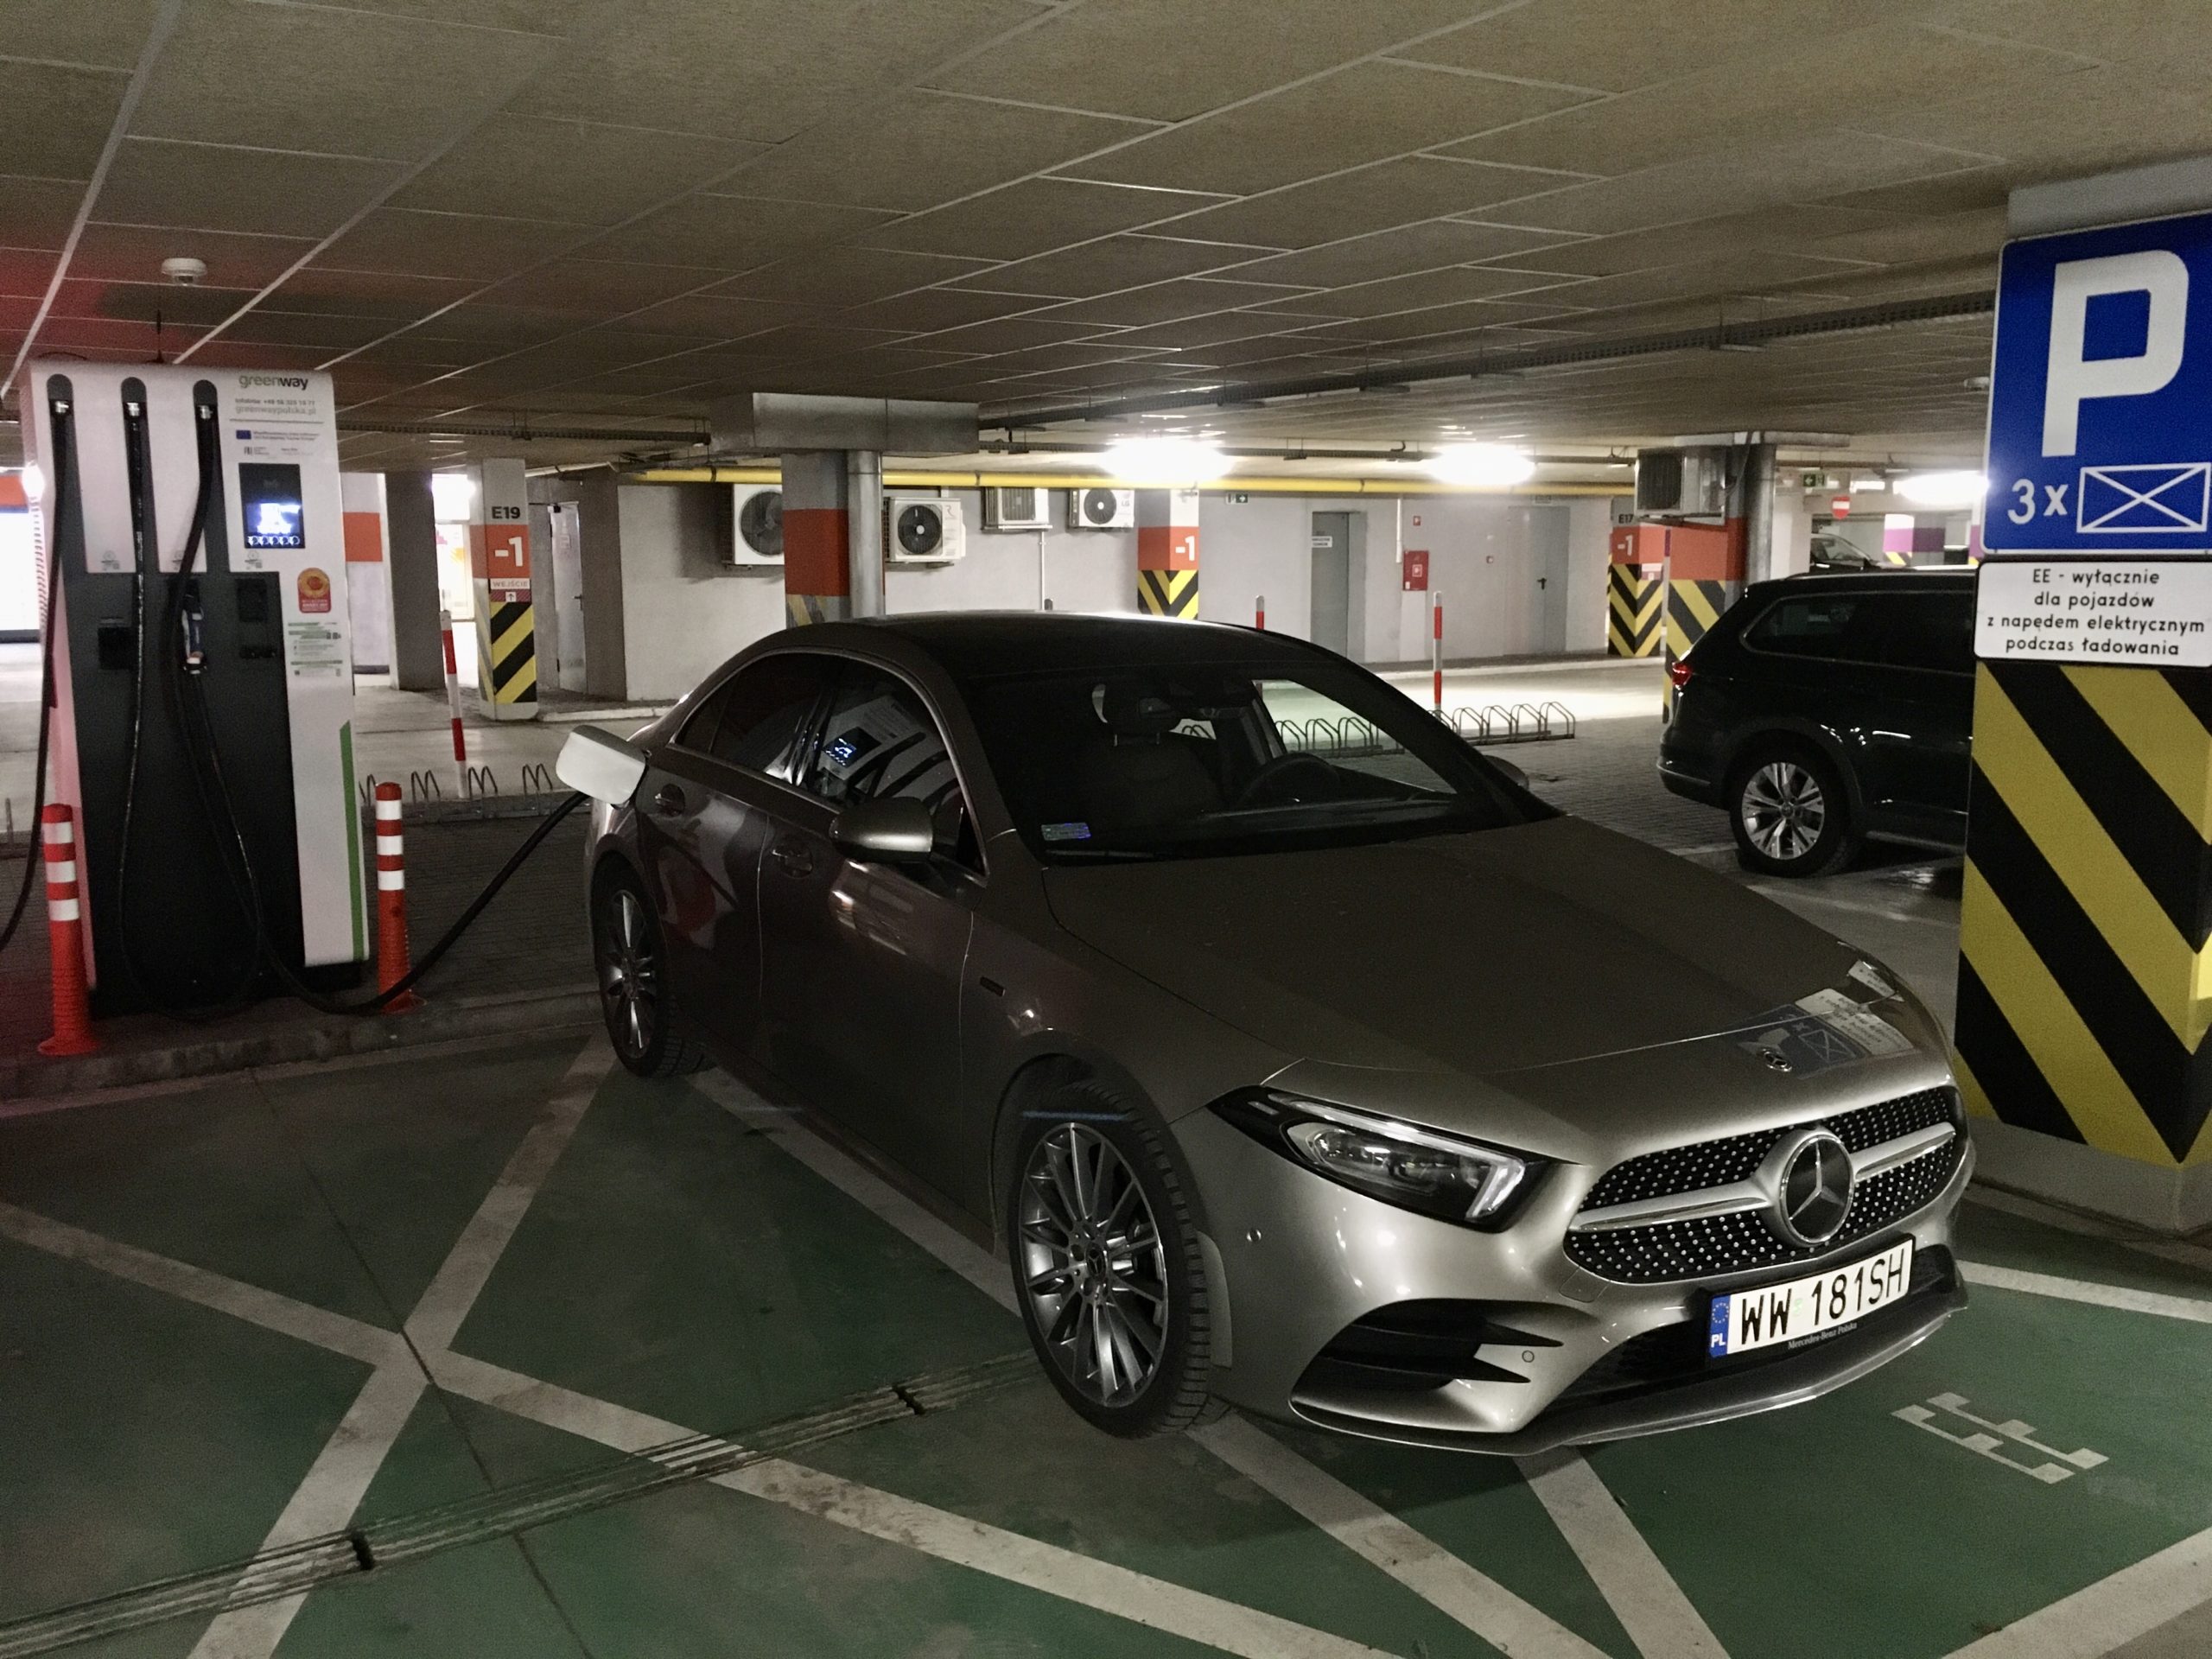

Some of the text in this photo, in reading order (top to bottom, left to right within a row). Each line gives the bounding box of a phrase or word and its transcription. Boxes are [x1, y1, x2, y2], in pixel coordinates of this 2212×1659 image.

[2042, 250, 2190, 457] P
[238, 375, 308, 391] greenway
[2007, 478, 2036, 524] 3
[492, 506, 521, 519] E19
[1618, 513, 1634, 524] E17
[494, 537, 524, 567] -1
[1175, 536, 1195, 562] -1
[1618, 535, 1633, 556] -1
[2032, 569, 2051, 584] EE
[2072, 569, 2160, 588] wyłącznie
[2034, 591, 2155, 610] dla pojazdów
[1987, 613, 2205, 637] z napędem elektrycznym
[2005, 636, 2179, 656] podczas ładowania
[1741, 1248, 1904, 1345] WW 181SH
[1710, 1333, 1726, 1348] PL
[1788, 1330, 1836, 1350] Mercedes-Benz
